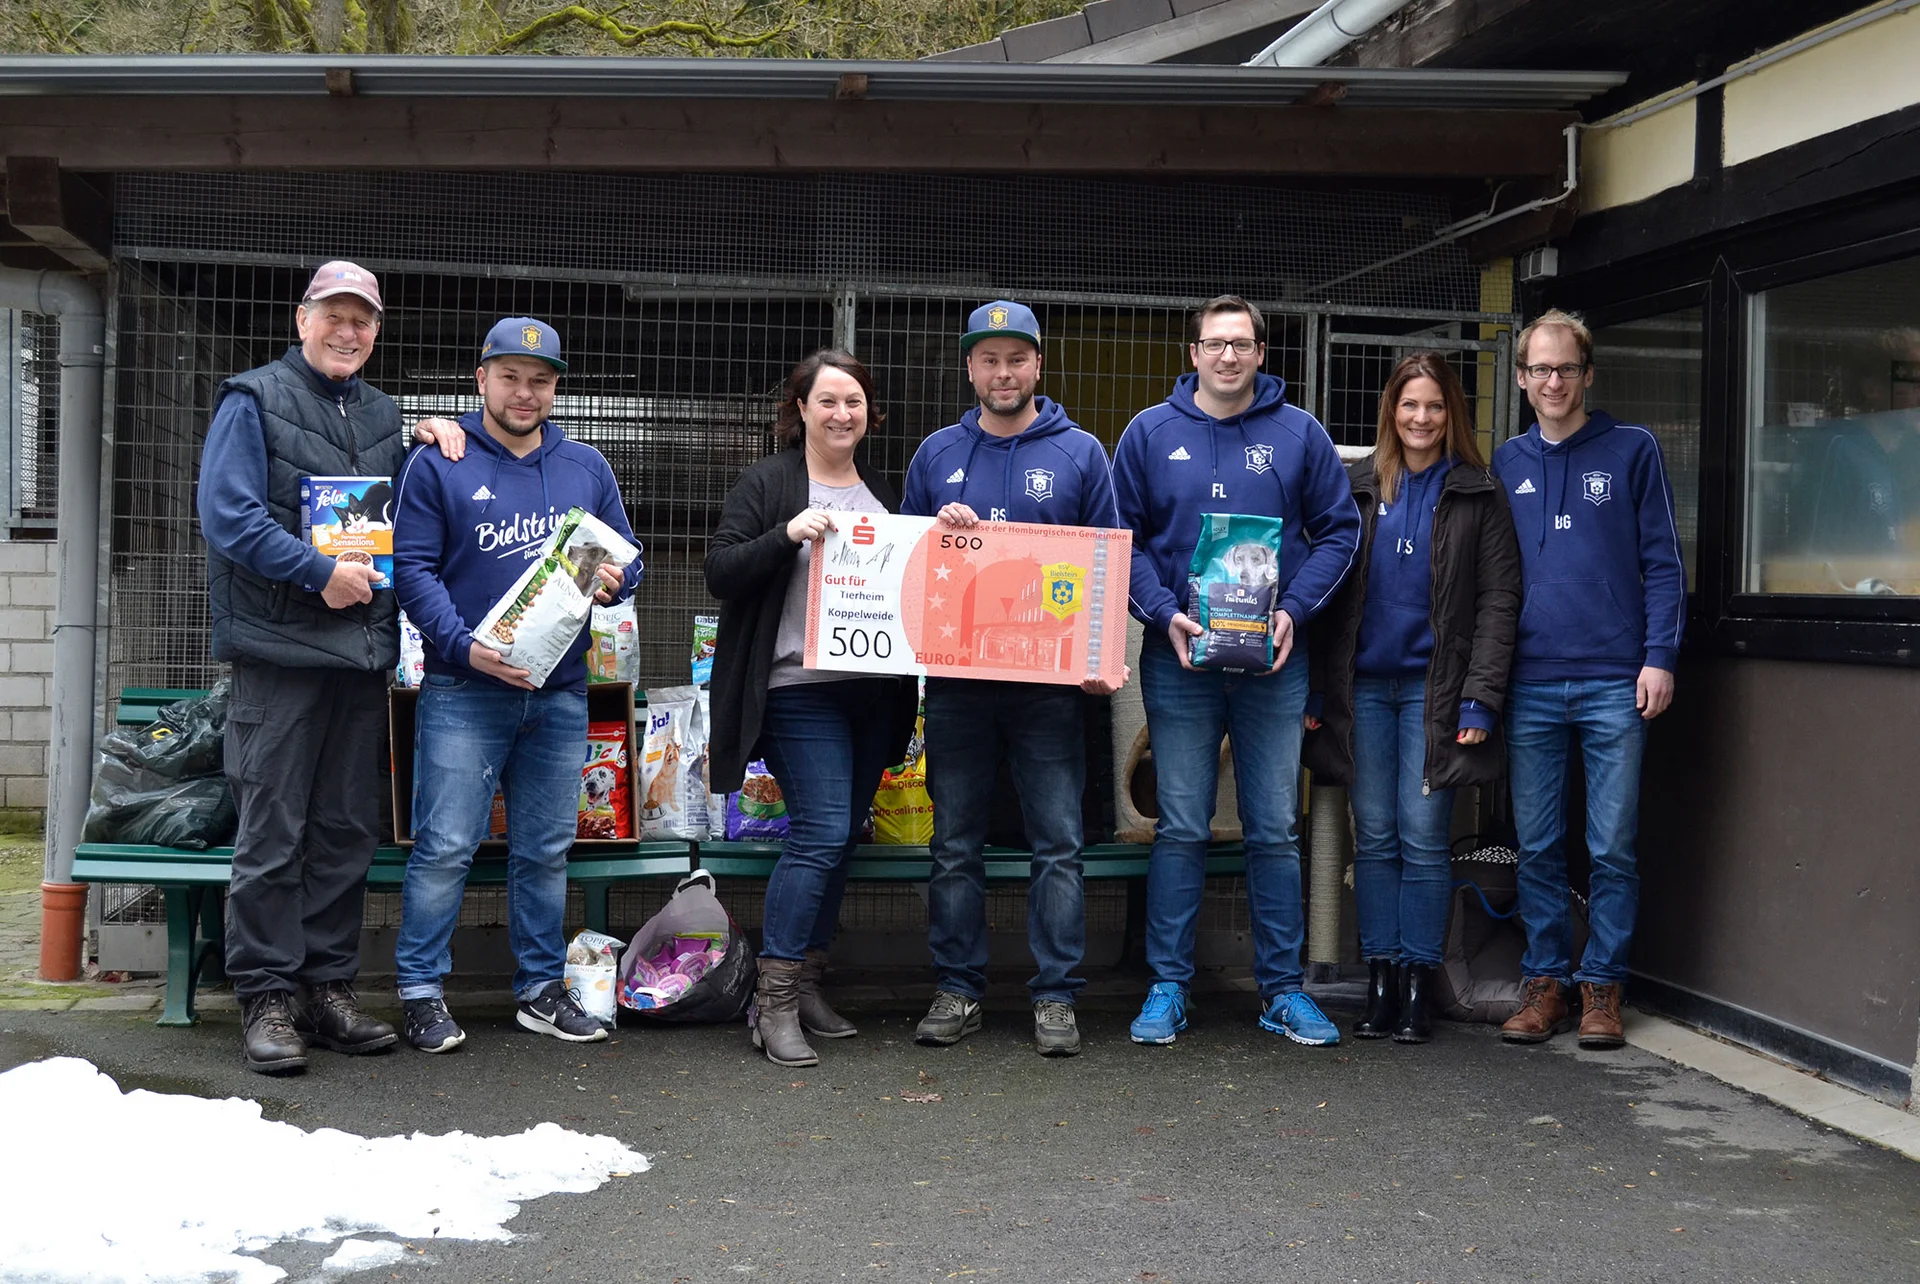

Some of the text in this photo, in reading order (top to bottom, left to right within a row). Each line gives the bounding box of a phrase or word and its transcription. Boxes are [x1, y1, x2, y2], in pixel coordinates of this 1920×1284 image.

[1212, 483, 1227, 498] FL
[315, 489, 348, 511] felix
[991, 508, 1006, 521] RS
[992, 525, 1006, 533] der
[1009, 526, 1077, 539] Homburgischen
[1079, 530, 1128, 541] Gemeinden
[332, 539, 375, 547] Sensations
[940, 535, 983, 550] 500
[825, 574, 867, 588] Gut für
[840, 590, 885, 602] Tierheim
[593, 612, 621, 622] TOPIC
[828, 608, 894, 622] Koppelweide
[1211, 620, 1226, 628] 20%
[829, 627, 892, 659] 500
[915, 652, 956, 666] EURO
[650, 711, 670, 736] ja!
[580, 933, 610, 947] TOPIC
